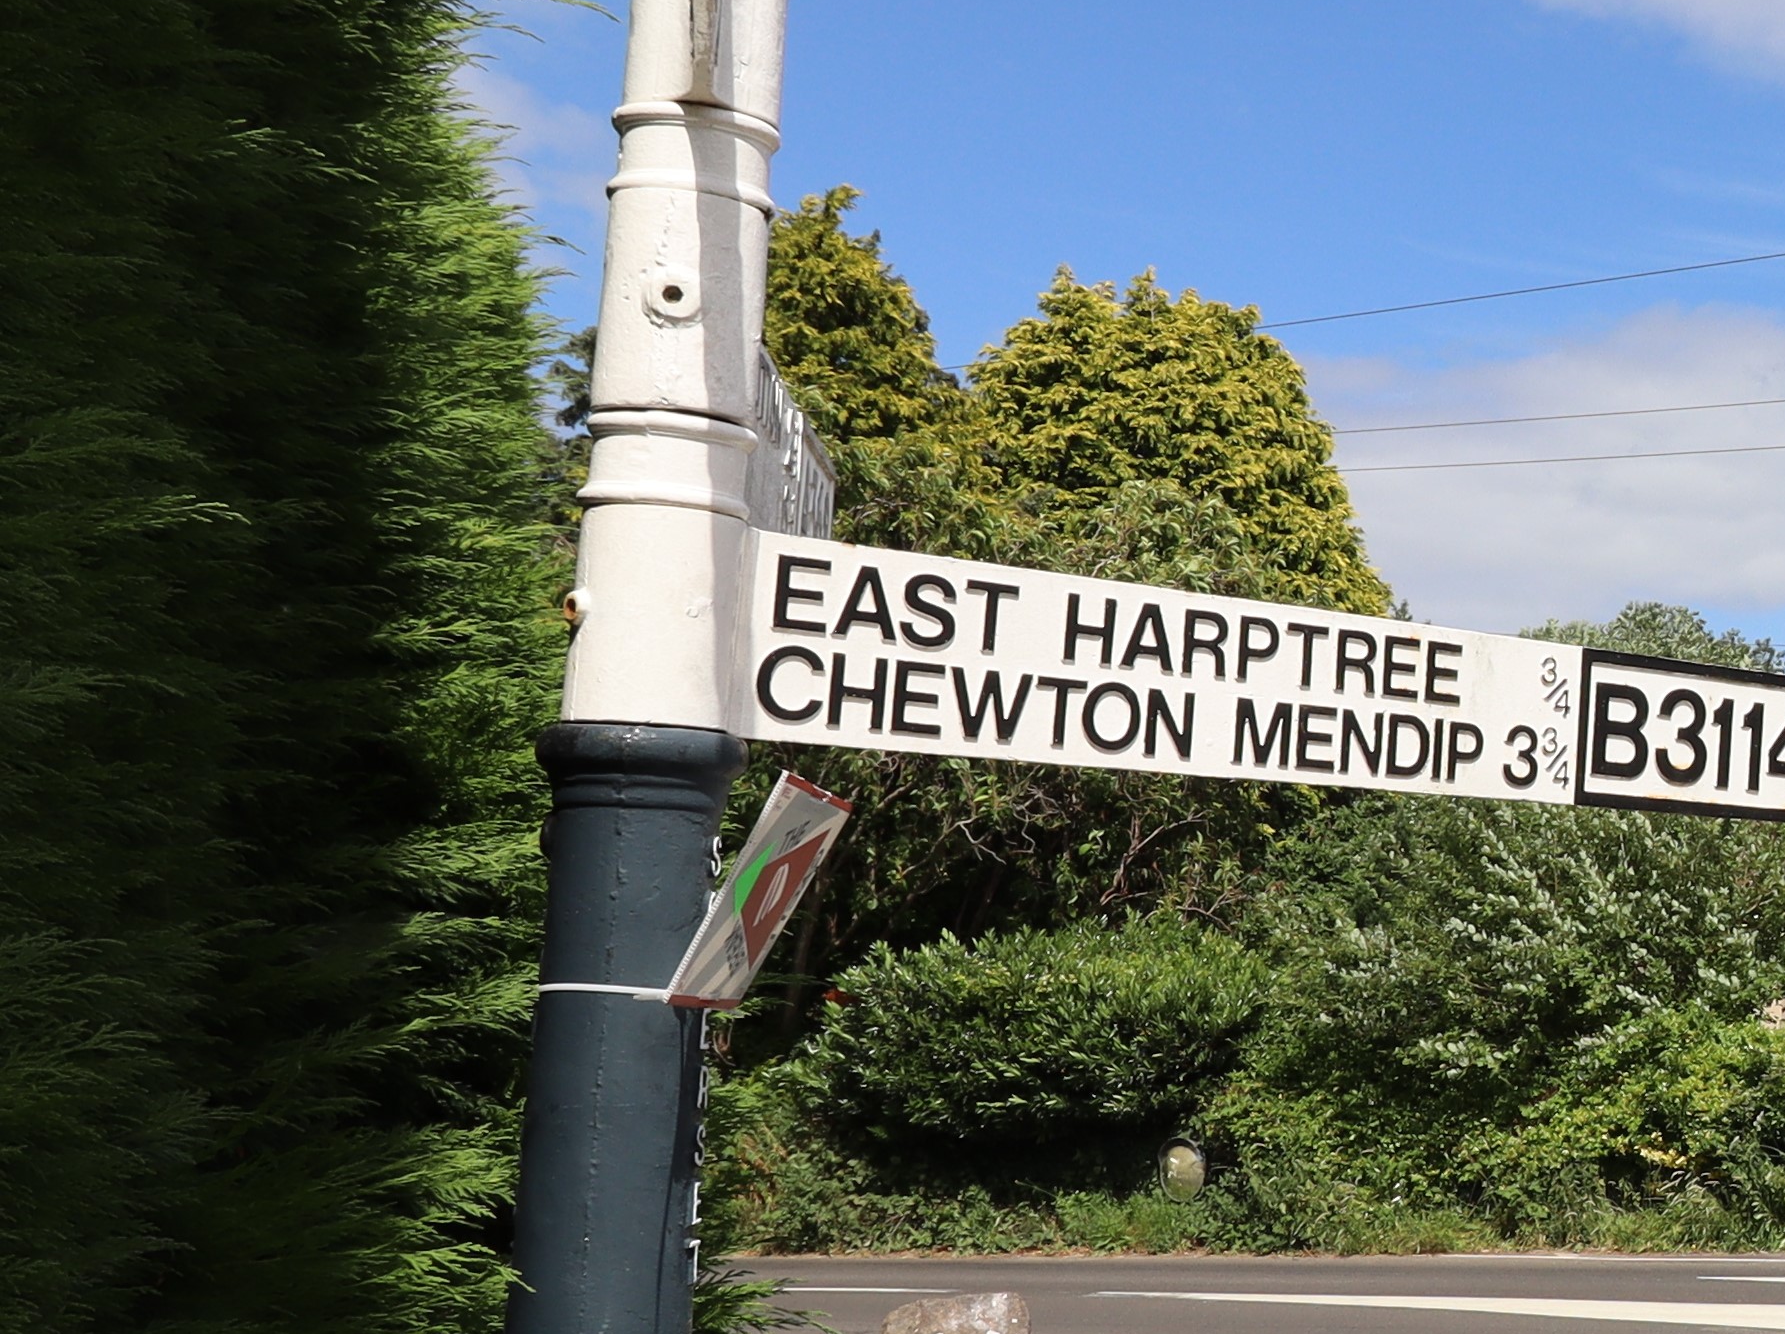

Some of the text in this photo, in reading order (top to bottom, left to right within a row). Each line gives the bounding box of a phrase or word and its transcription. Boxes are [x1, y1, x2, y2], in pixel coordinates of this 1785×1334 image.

[770, 553, 1020, 655] EAST
[1062, 592, 1463, 706] HARPTREE
[756, 644, 1195, 762] CHEWTON
[1231, 697, 1484, 784] MENDIP
